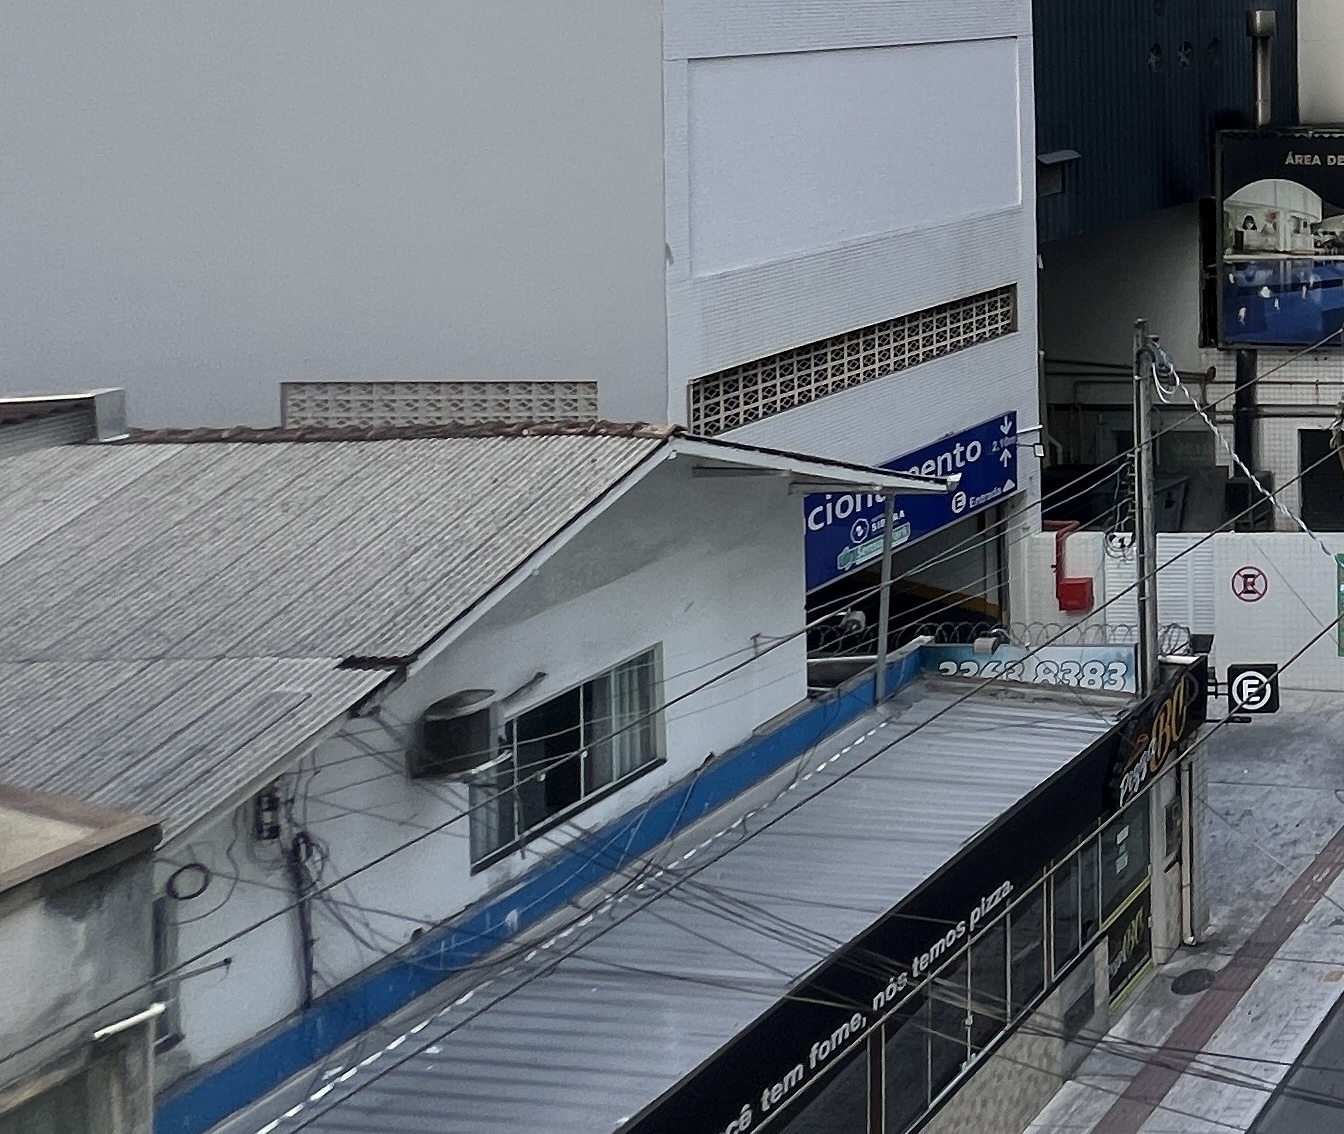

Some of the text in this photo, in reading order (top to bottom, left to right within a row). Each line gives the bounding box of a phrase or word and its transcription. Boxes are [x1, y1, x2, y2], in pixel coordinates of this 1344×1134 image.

[1285, 151, 1321, 165] ÁREA
[761, 1064, 804, 1112] tem
[809, 1012, 867, 1069] fome,
[872, 971, 908, 1011] nós
[911, 920, 966, 978] temos
